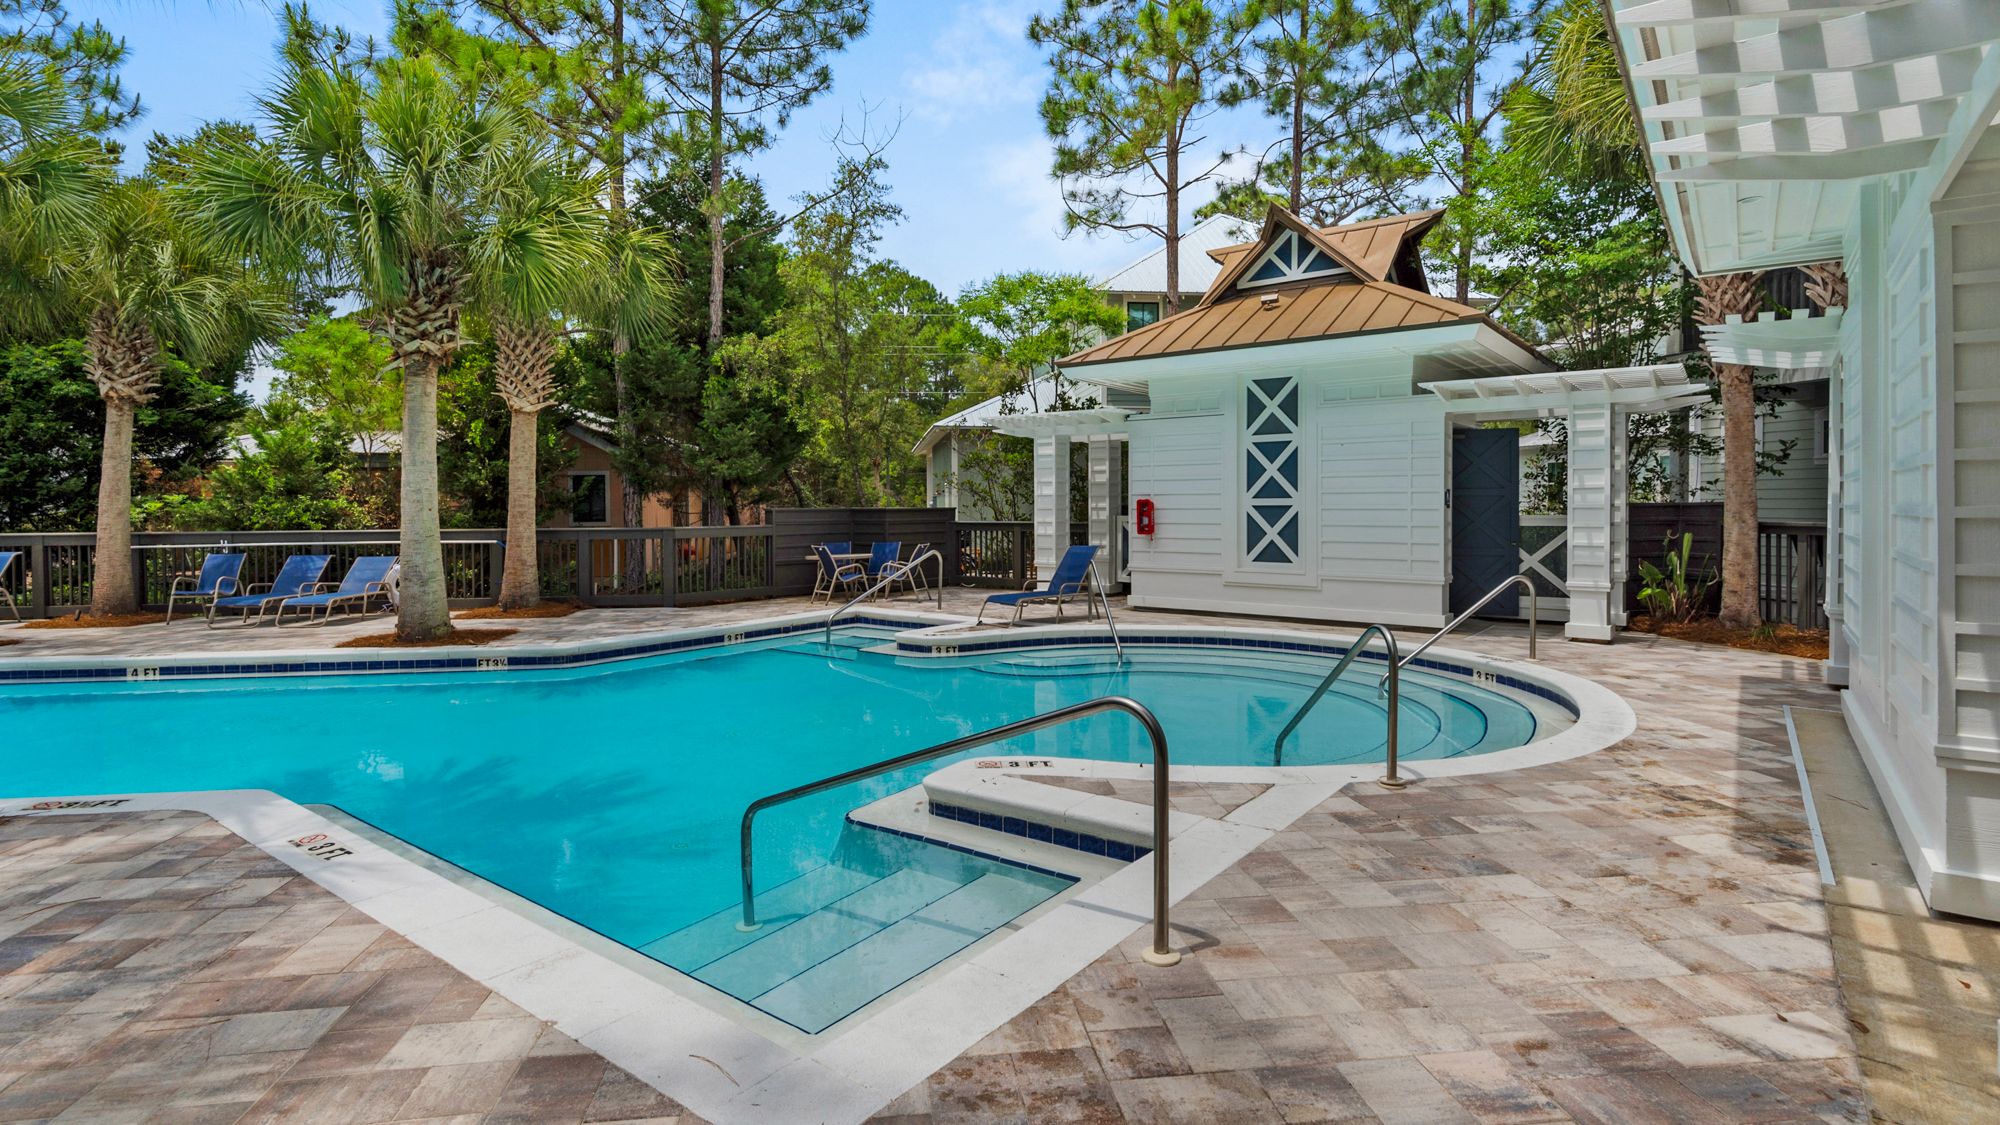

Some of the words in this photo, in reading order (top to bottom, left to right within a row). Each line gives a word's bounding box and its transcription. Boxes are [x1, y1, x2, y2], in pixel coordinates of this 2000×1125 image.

[131, 668, 139, 676] 4
[144, 667, 158, 676] FT
[1485, 672, 1495, 682] FT
[307, 842, 336, 851] 3
[315, 847, 354, 861] FT
